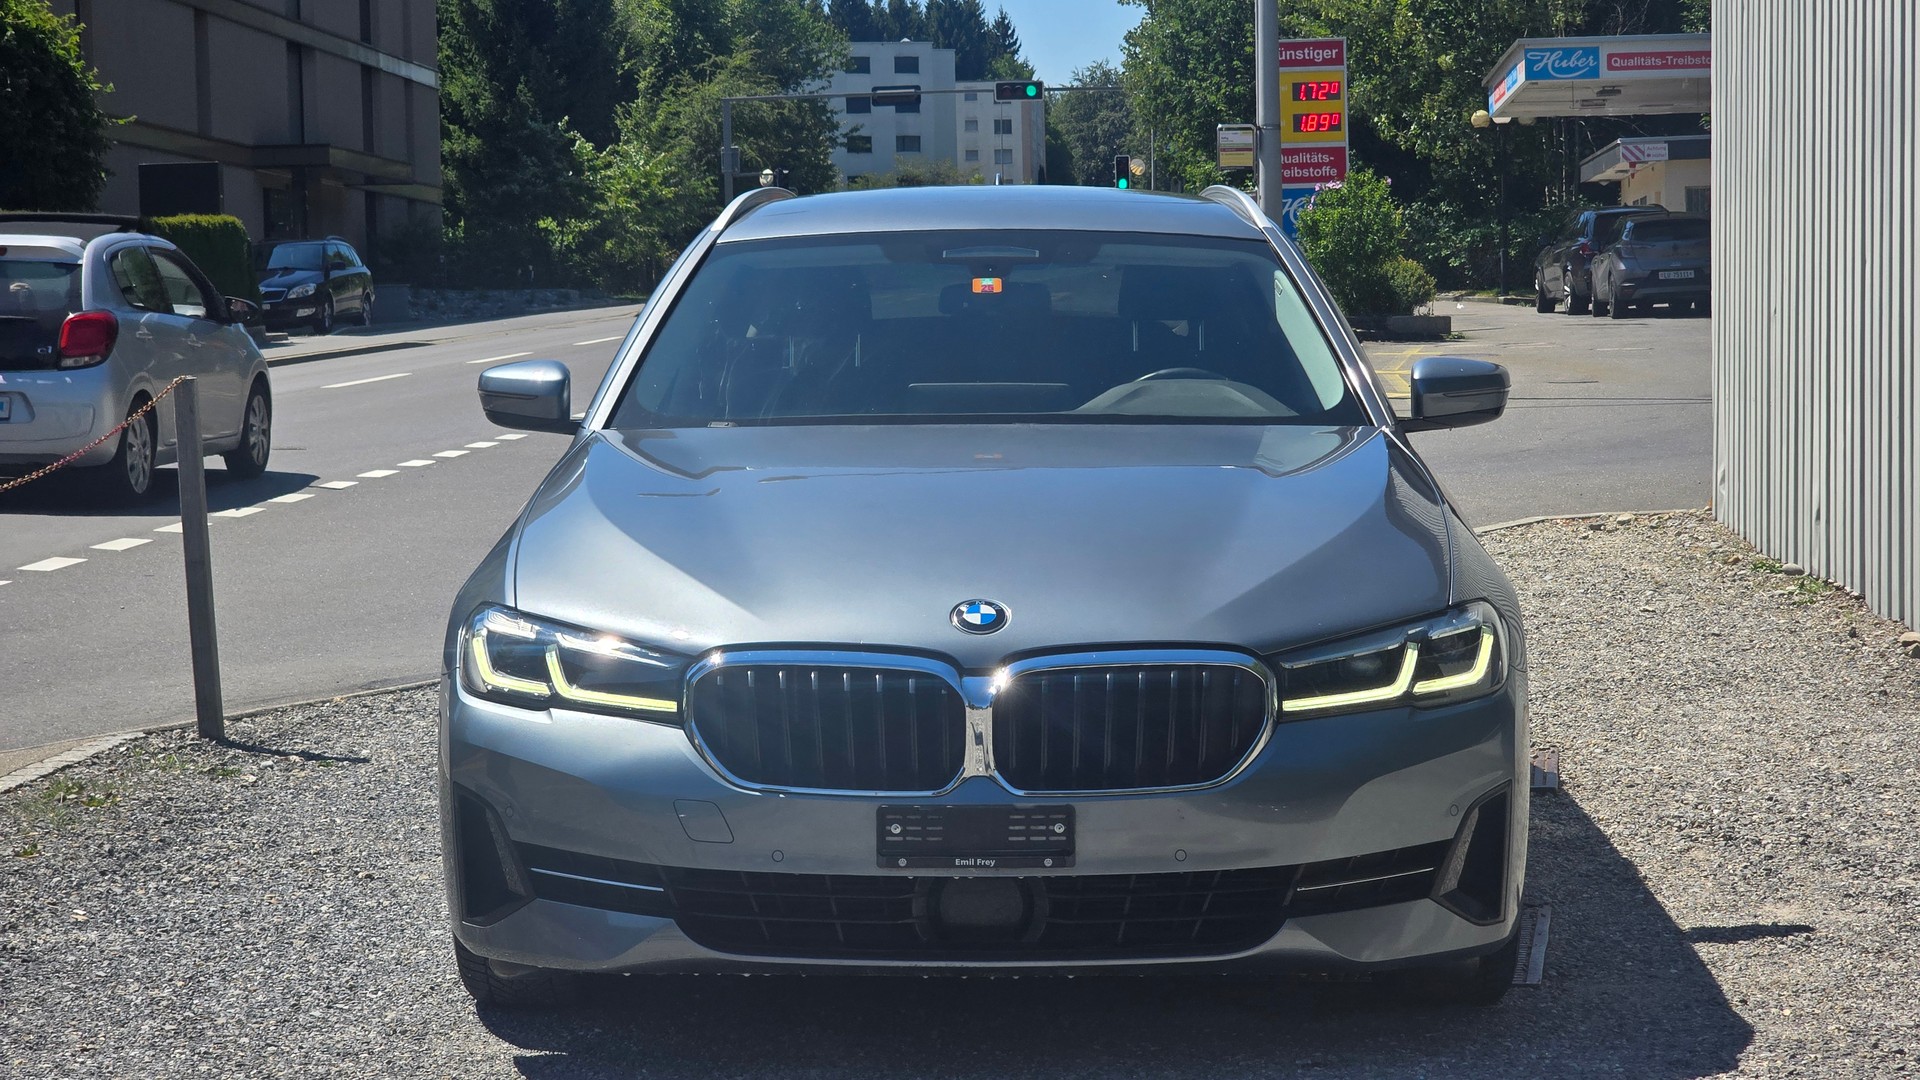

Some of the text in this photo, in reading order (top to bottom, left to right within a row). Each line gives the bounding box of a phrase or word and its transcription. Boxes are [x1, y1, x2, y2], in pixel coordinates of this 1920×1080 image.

[1526, 50, 1597, 78] Huber
[955, 858, 996, 867] Emil Frey
